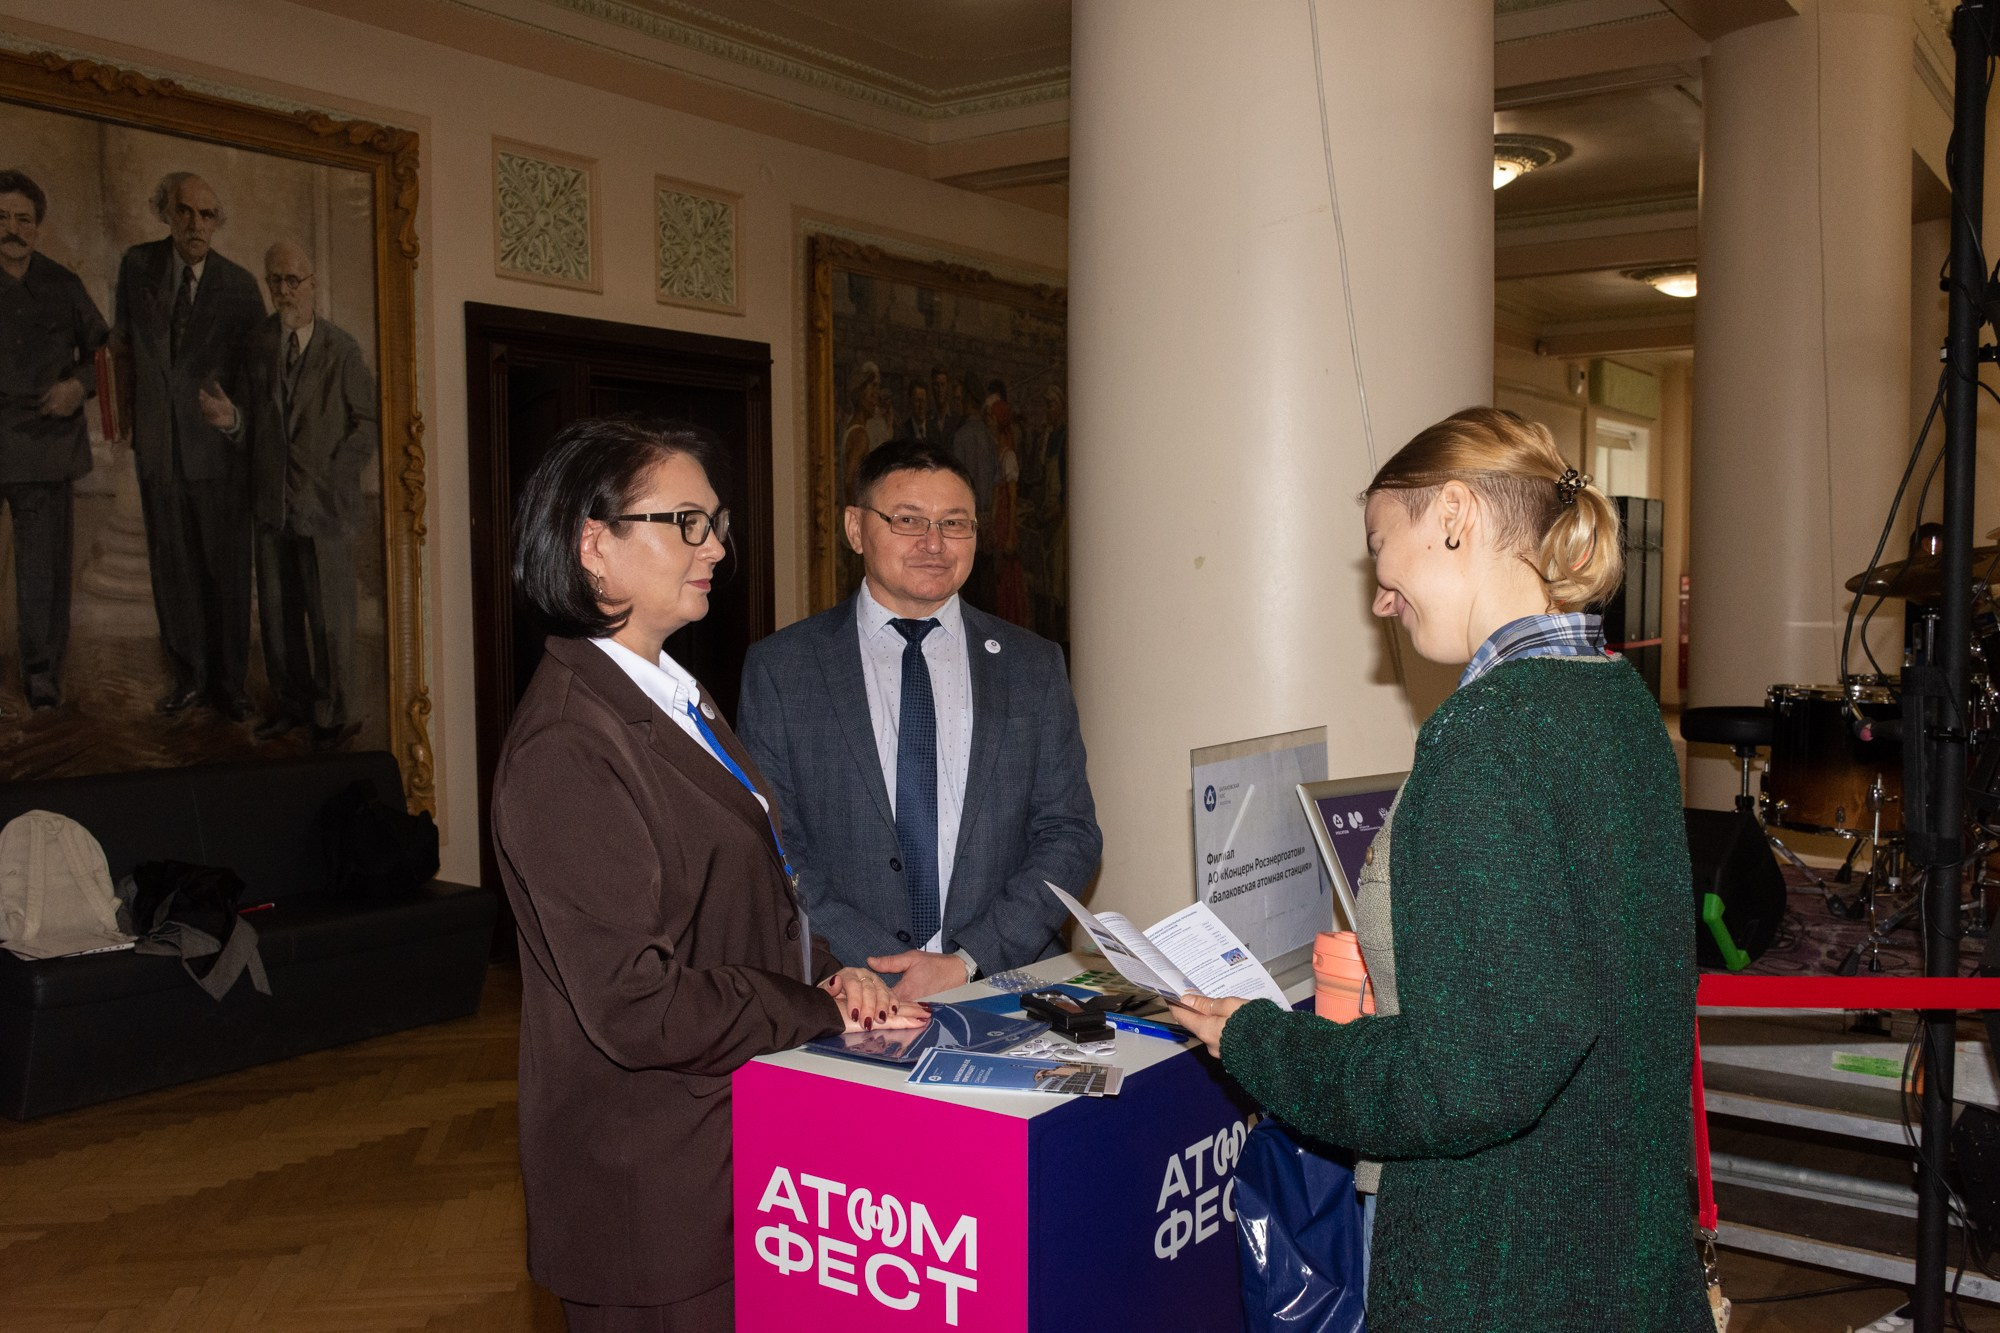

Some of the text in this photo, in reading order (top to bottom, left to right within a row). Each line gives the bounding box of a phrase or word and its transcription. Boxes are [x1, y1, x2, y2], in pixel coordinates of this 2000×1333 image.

[1207, 846, 1306, 886] АО «Концерн Росэнергоатом»
[1208, 861, 1313, 905] «Балаковская атомная станция»
[755, 1223, 978, 1327] ФЕСТ
